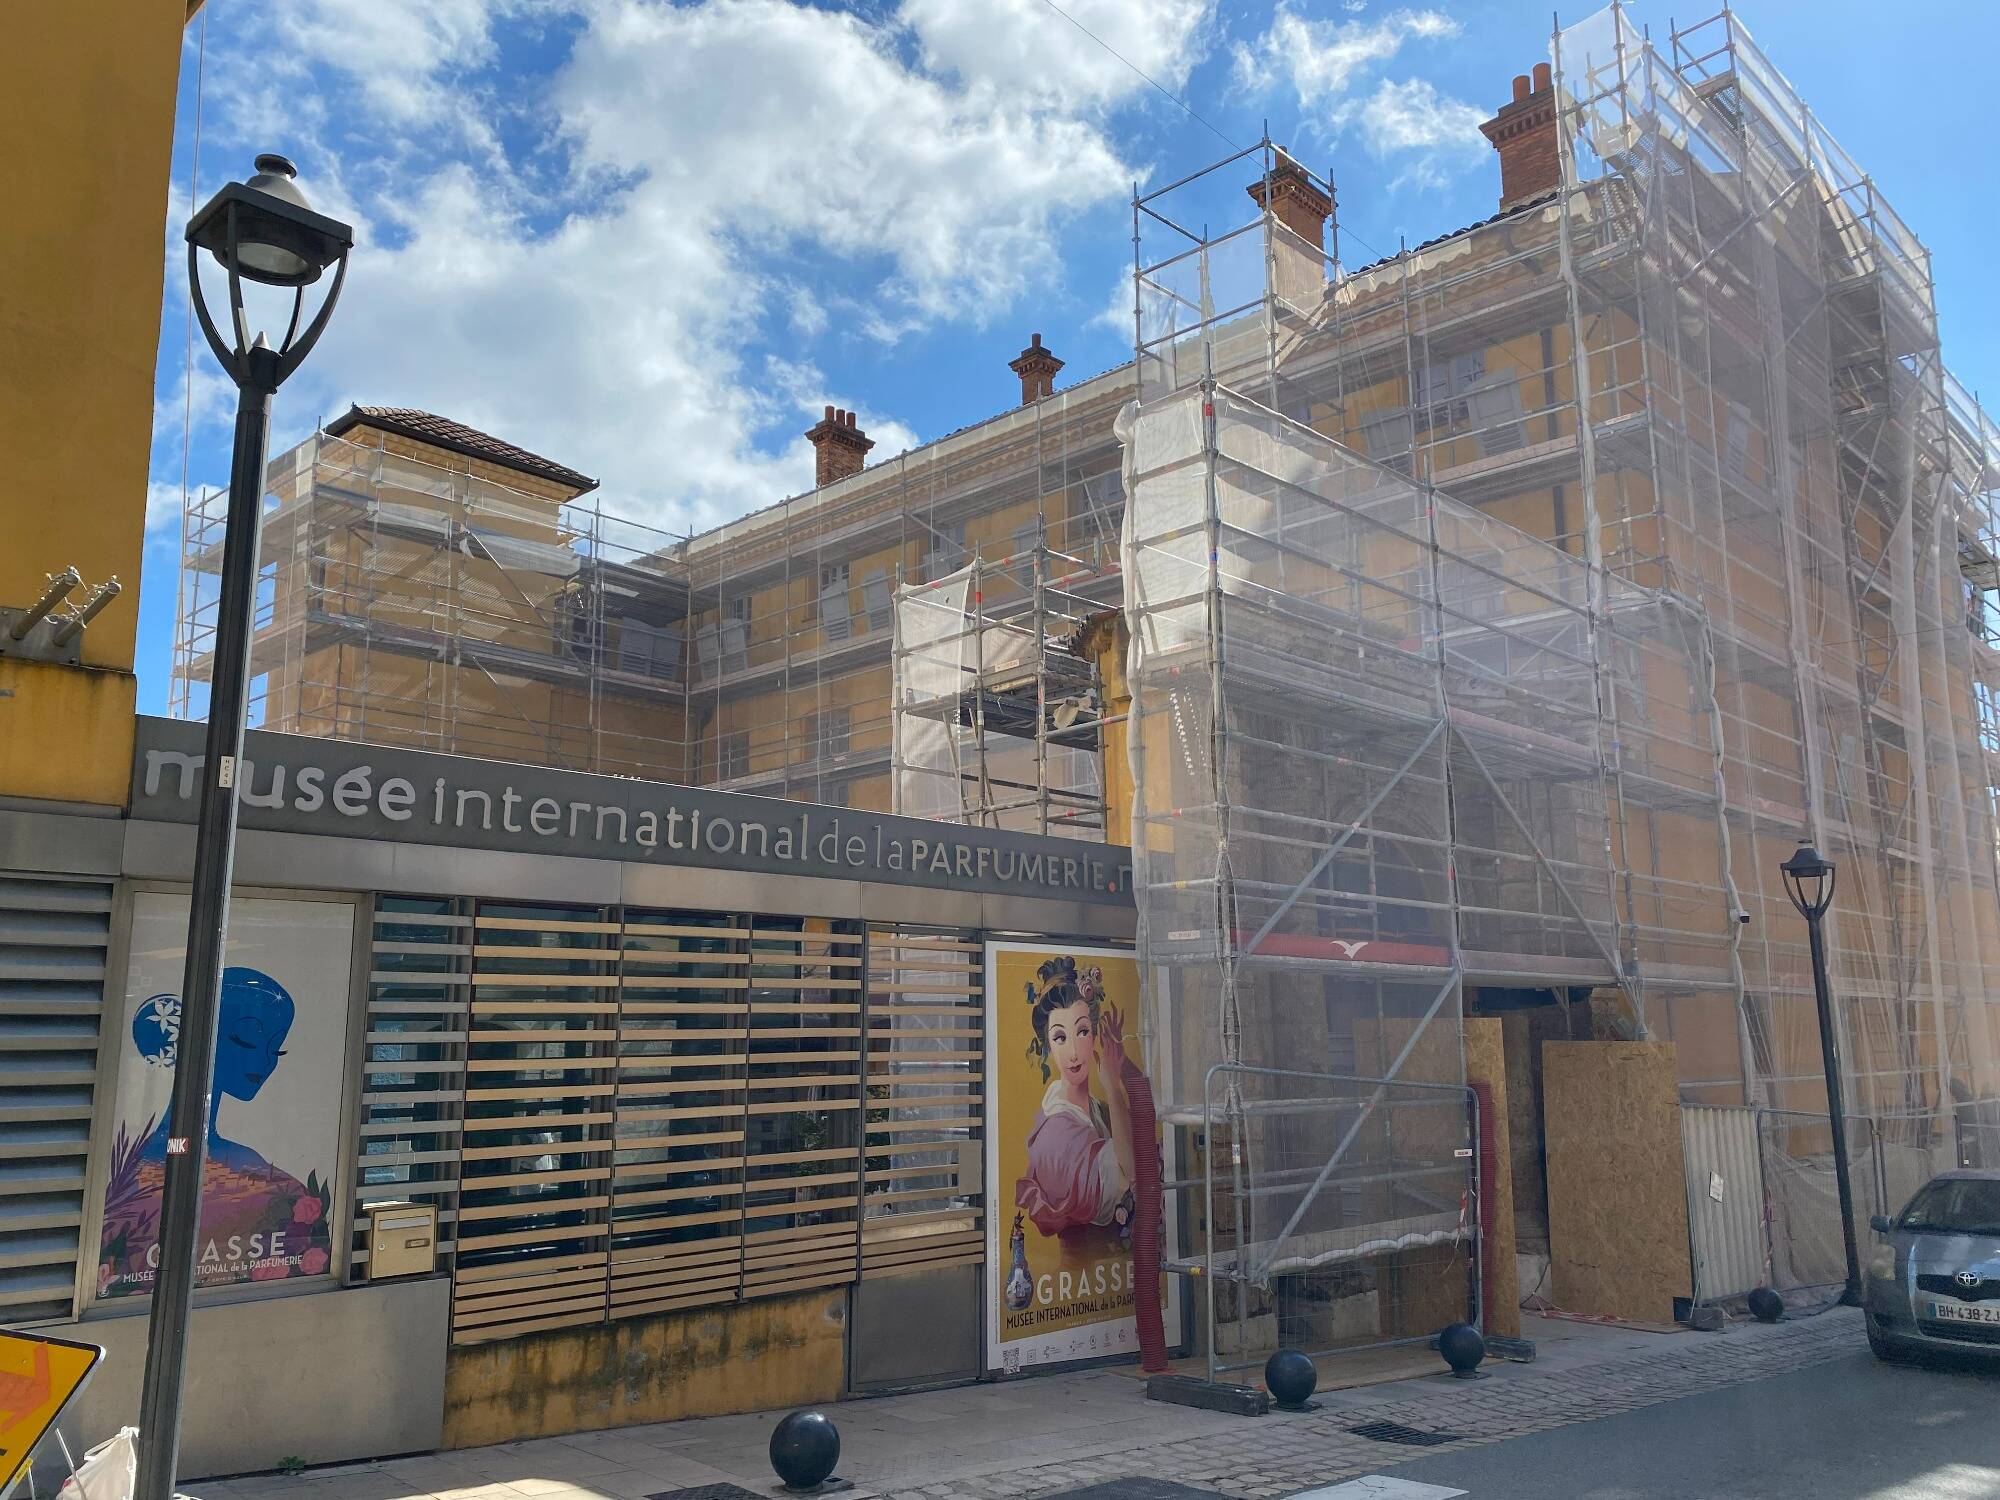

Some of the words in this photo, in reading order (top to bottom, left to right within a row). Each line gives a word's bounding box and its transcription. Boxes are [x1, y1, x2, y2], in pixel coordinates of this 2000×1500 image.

[145, 749, 416, 823] musée
[432, 777, 808, 861] international
[818, 818, 866, 866] de
[874, 825, 904, 871] la
[146, 1231, 287, 1269] GASSE
[230, 1262, 240, 1272] de
[249, 1254, 303, 1270] PARFUMERIE
[1036, 1260, 1135, 1305] GRASSE
[1036, 1300, 1100, 1324] INTERNATIONAL
